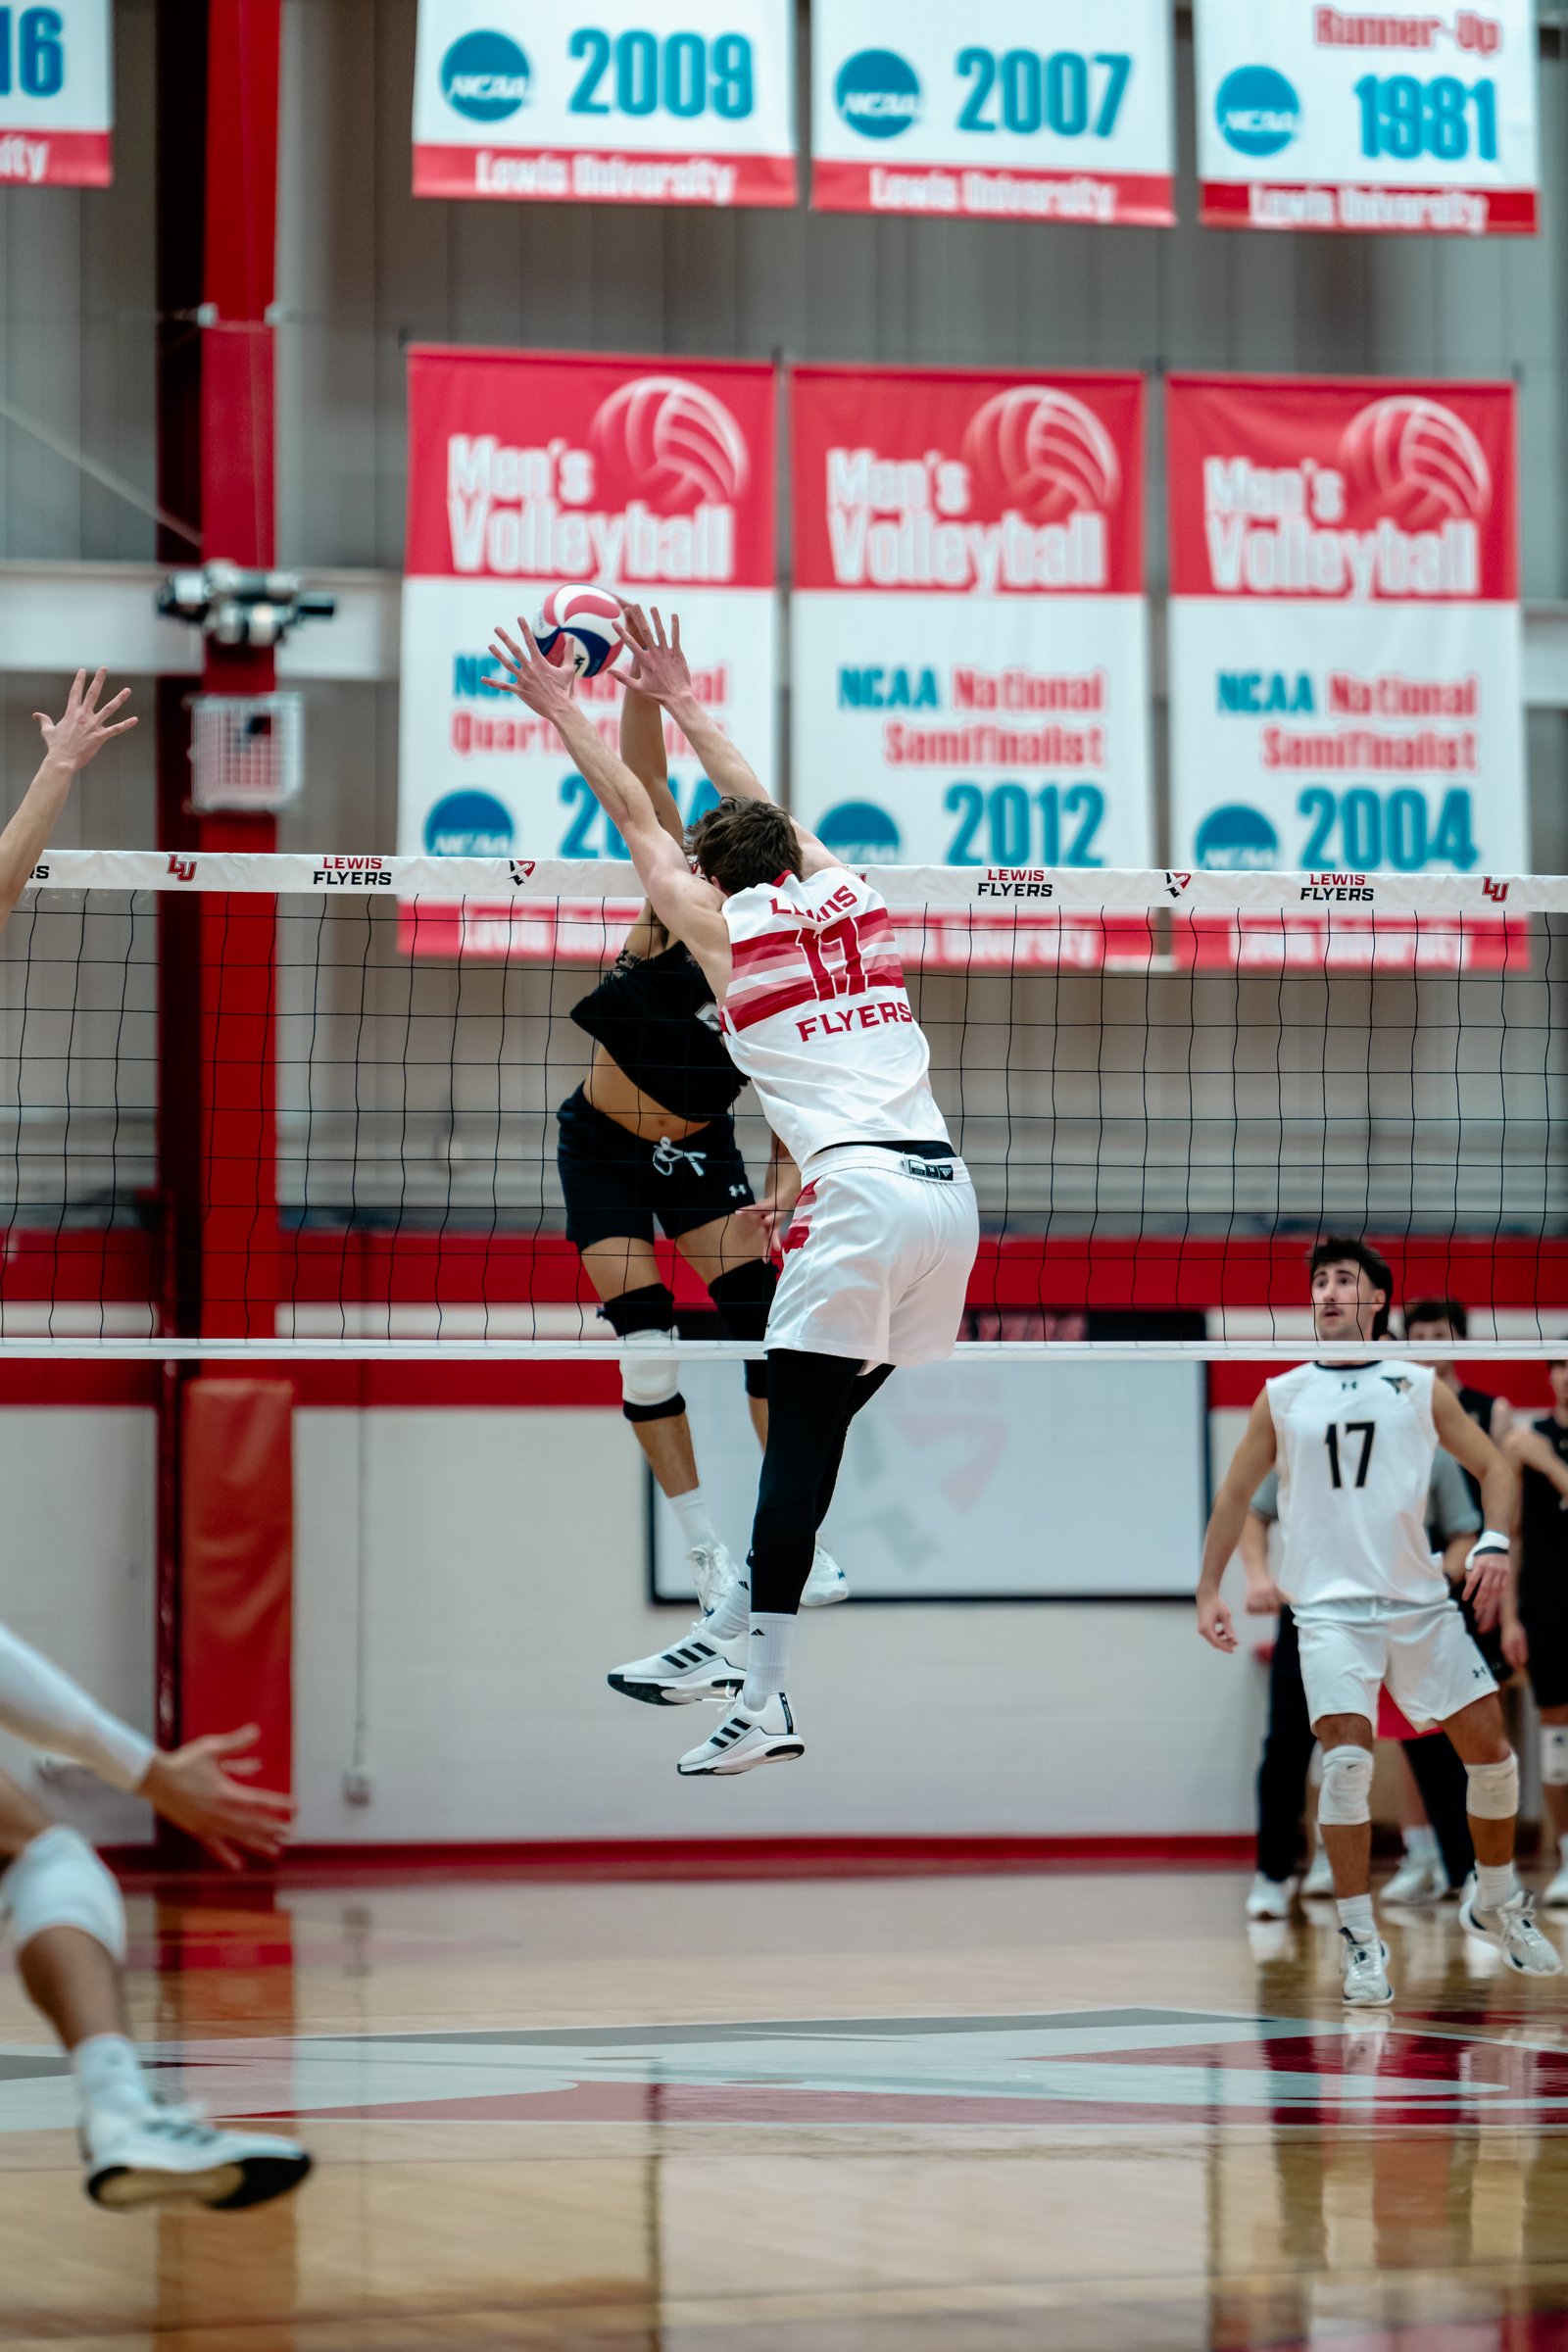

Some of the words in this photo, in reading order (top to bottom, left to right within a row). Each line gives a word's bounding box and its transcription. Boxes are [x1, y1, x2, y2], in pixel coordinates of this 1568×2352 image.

[1313, 5, 1500, 56] Runner-Up
[566, 27, 754, 120] 2009
[956, 46, 1132, 137] 2007
[1354, 74, 1499, 163] 1981
[475, 151, 565, 196] Lewis
[571, 155, 735, 205] University
[447, 434, 593, 504] Men's
[826, 448, 969, 514] Men's
[1203, 456, 1344, 521] Men's
[448, 501, 736, 588] Volleyball
[827, 510, 1105, 594] Volleyball
[1204, 517, 1480, 600] Volleyball
[838, 666, 938, 711] NCAA
[952, 666, 1105, 713] National
[1217, 669, 1315, 714] NCAA
[1328, 670, 1480, 718] National
[884, 719, 1105, 769] Semifinalist
[1261, 723, 1478, 773] Semifinalist
[945, 782, 1104, 867] 2012
[1298, 787, 1479, 871] 2004
[167, 854, 197, 882] LU
[314, 871, 392, 886] FLYERS
[322, 857, 383, 869] LEWIS
[987, 869, 1045, 882] LEWIS
[1309, 874, 1366, 886] LEWIS
[1482, 875, 1510, 903] LU
[978, 883, 1054, 897] FLYERS
[1299, 887, 1375, 902] FLYERS
[796, 915, 868, 1002] 17
[796, 1002, 912, 1042] FLYERS
[1325, 1421, 1375, 1489] 17
